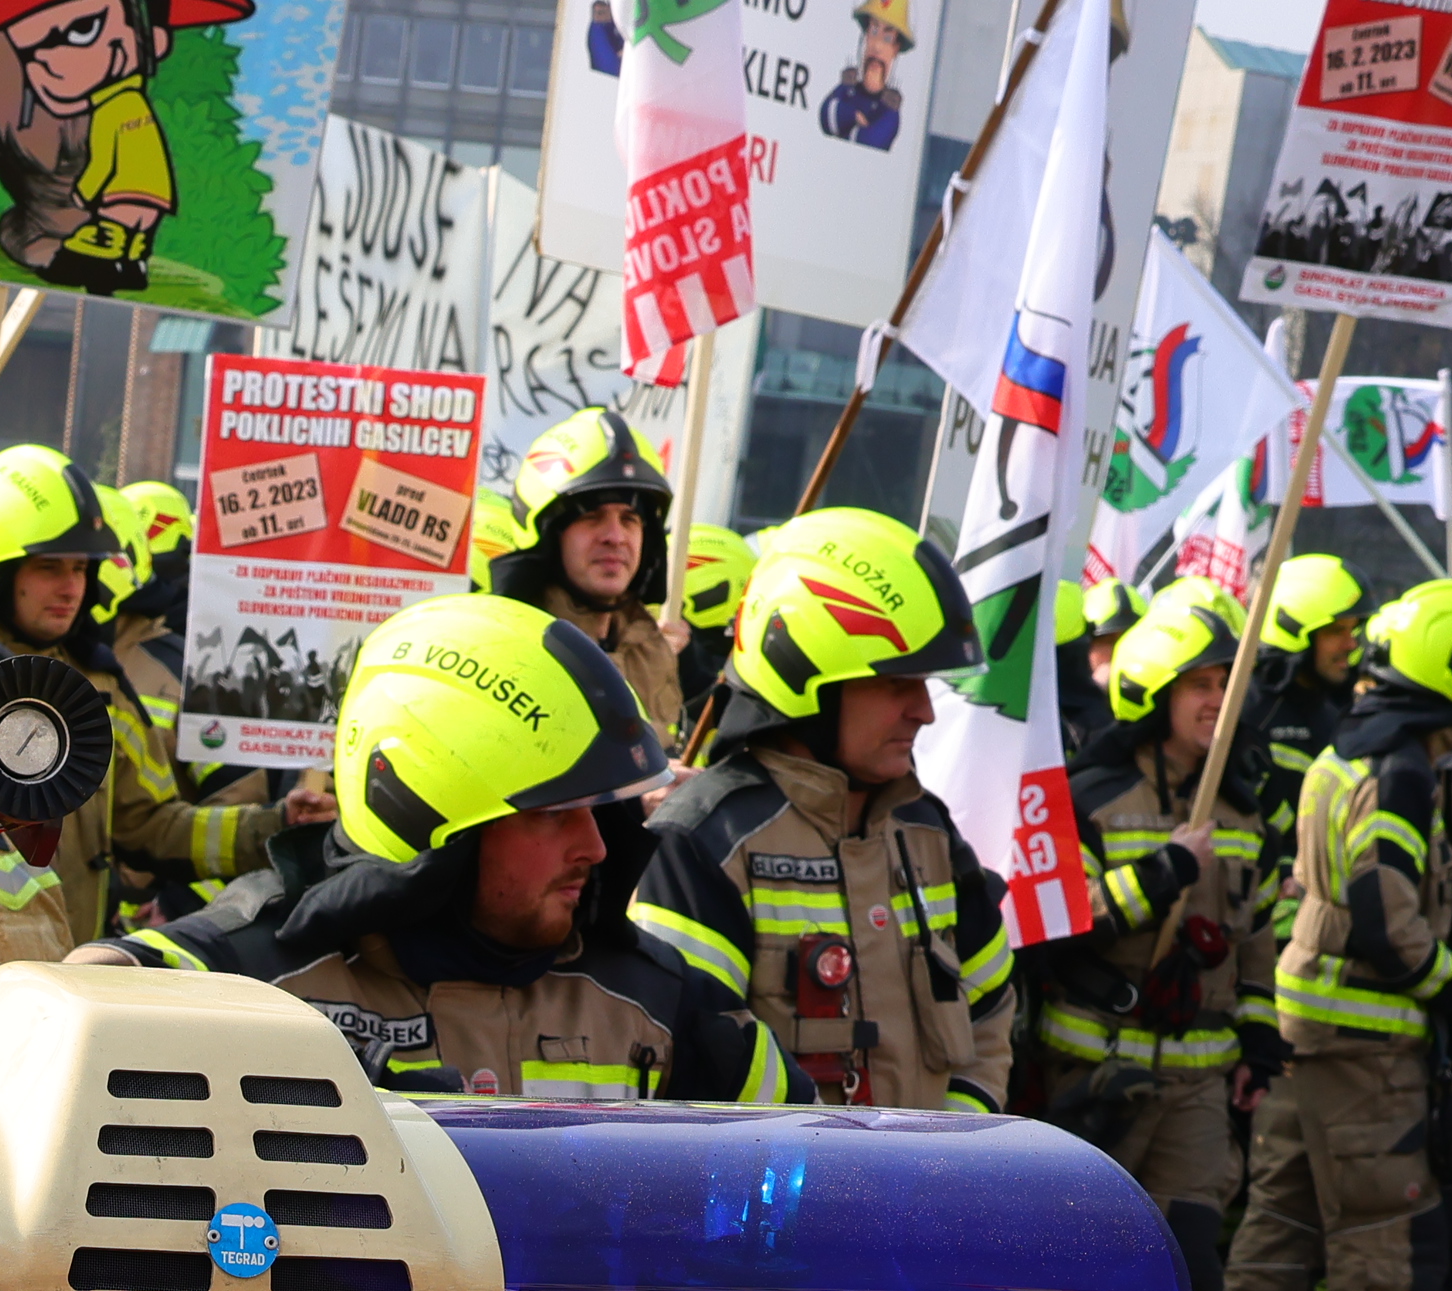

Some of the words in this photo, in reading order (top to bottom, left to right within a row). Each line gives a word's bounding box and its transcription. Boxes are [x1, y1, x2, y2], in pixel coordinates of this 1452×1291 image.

[1370, 39, 1417, 64] 2023
[221, 369, 385, 416] PROTESTNI
[389, 382, 477, 424] SHOD
[219, 410, 352, 448] POKLICNIH
[354, 419, 472, 459] GASILCEV
[217, 492, 246, 516] 16.
[248, 488, 268, 511] 2.
[270, 477, 318, 507] 2023
[355, 488, 420, 531] VLADO
[421, 514, 452, 543] RS
[258, 513, 283, 536] 11.
[842, 552, 906, 613] LOŽAR
[424, 644, 550, 733] VODUŠEK
[238, 740, 327, 759] GASILSTVA
[239, 722, 315, 743] SINDIKAT
[220, 1250, 266, 1267] TEGRAD
